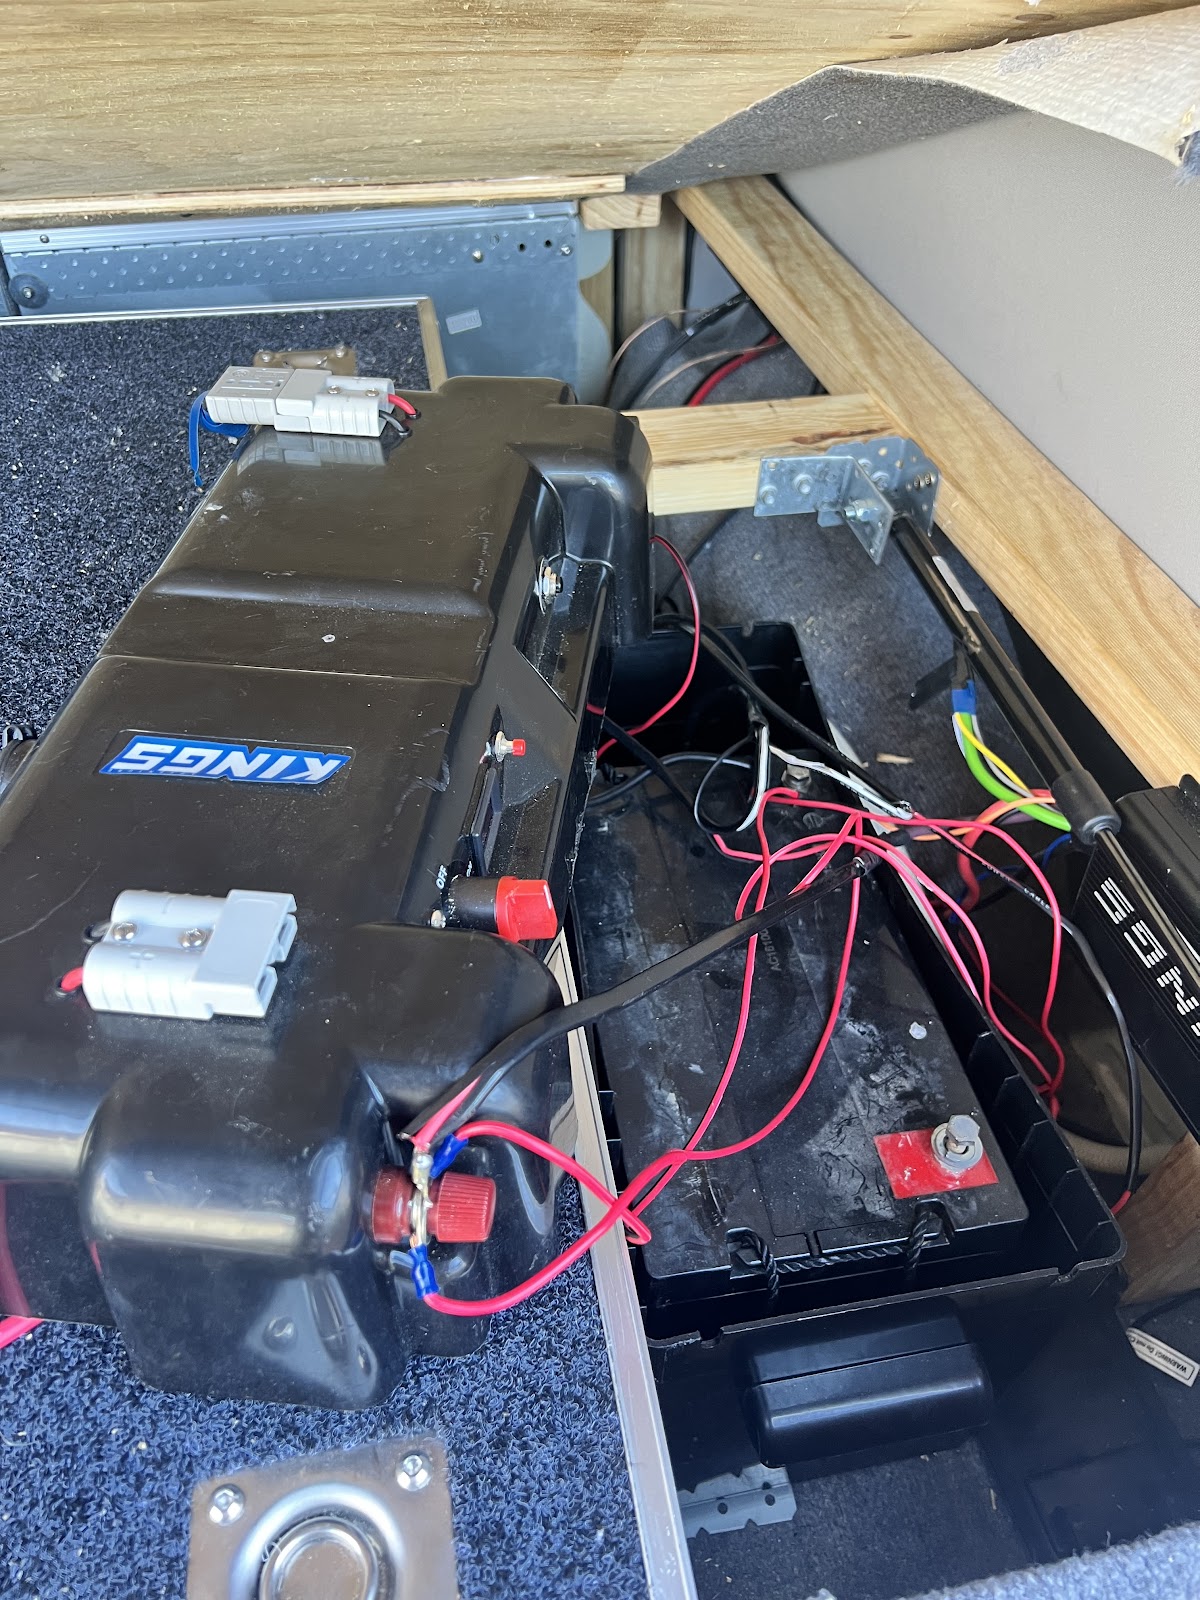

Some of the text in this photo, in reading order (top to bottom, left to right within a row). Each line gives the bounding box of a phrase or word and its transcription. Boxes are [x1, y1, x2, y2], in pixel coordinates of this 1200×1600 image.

[110, 742, 342, 780] KINGS
[435, 864, 448, 890] OFF
[1023, 886, 1052, 910] CABLE
[1093, 876, 1200, 1037] NGS
[1154, 1349, 1188, 1374] WARNING!
